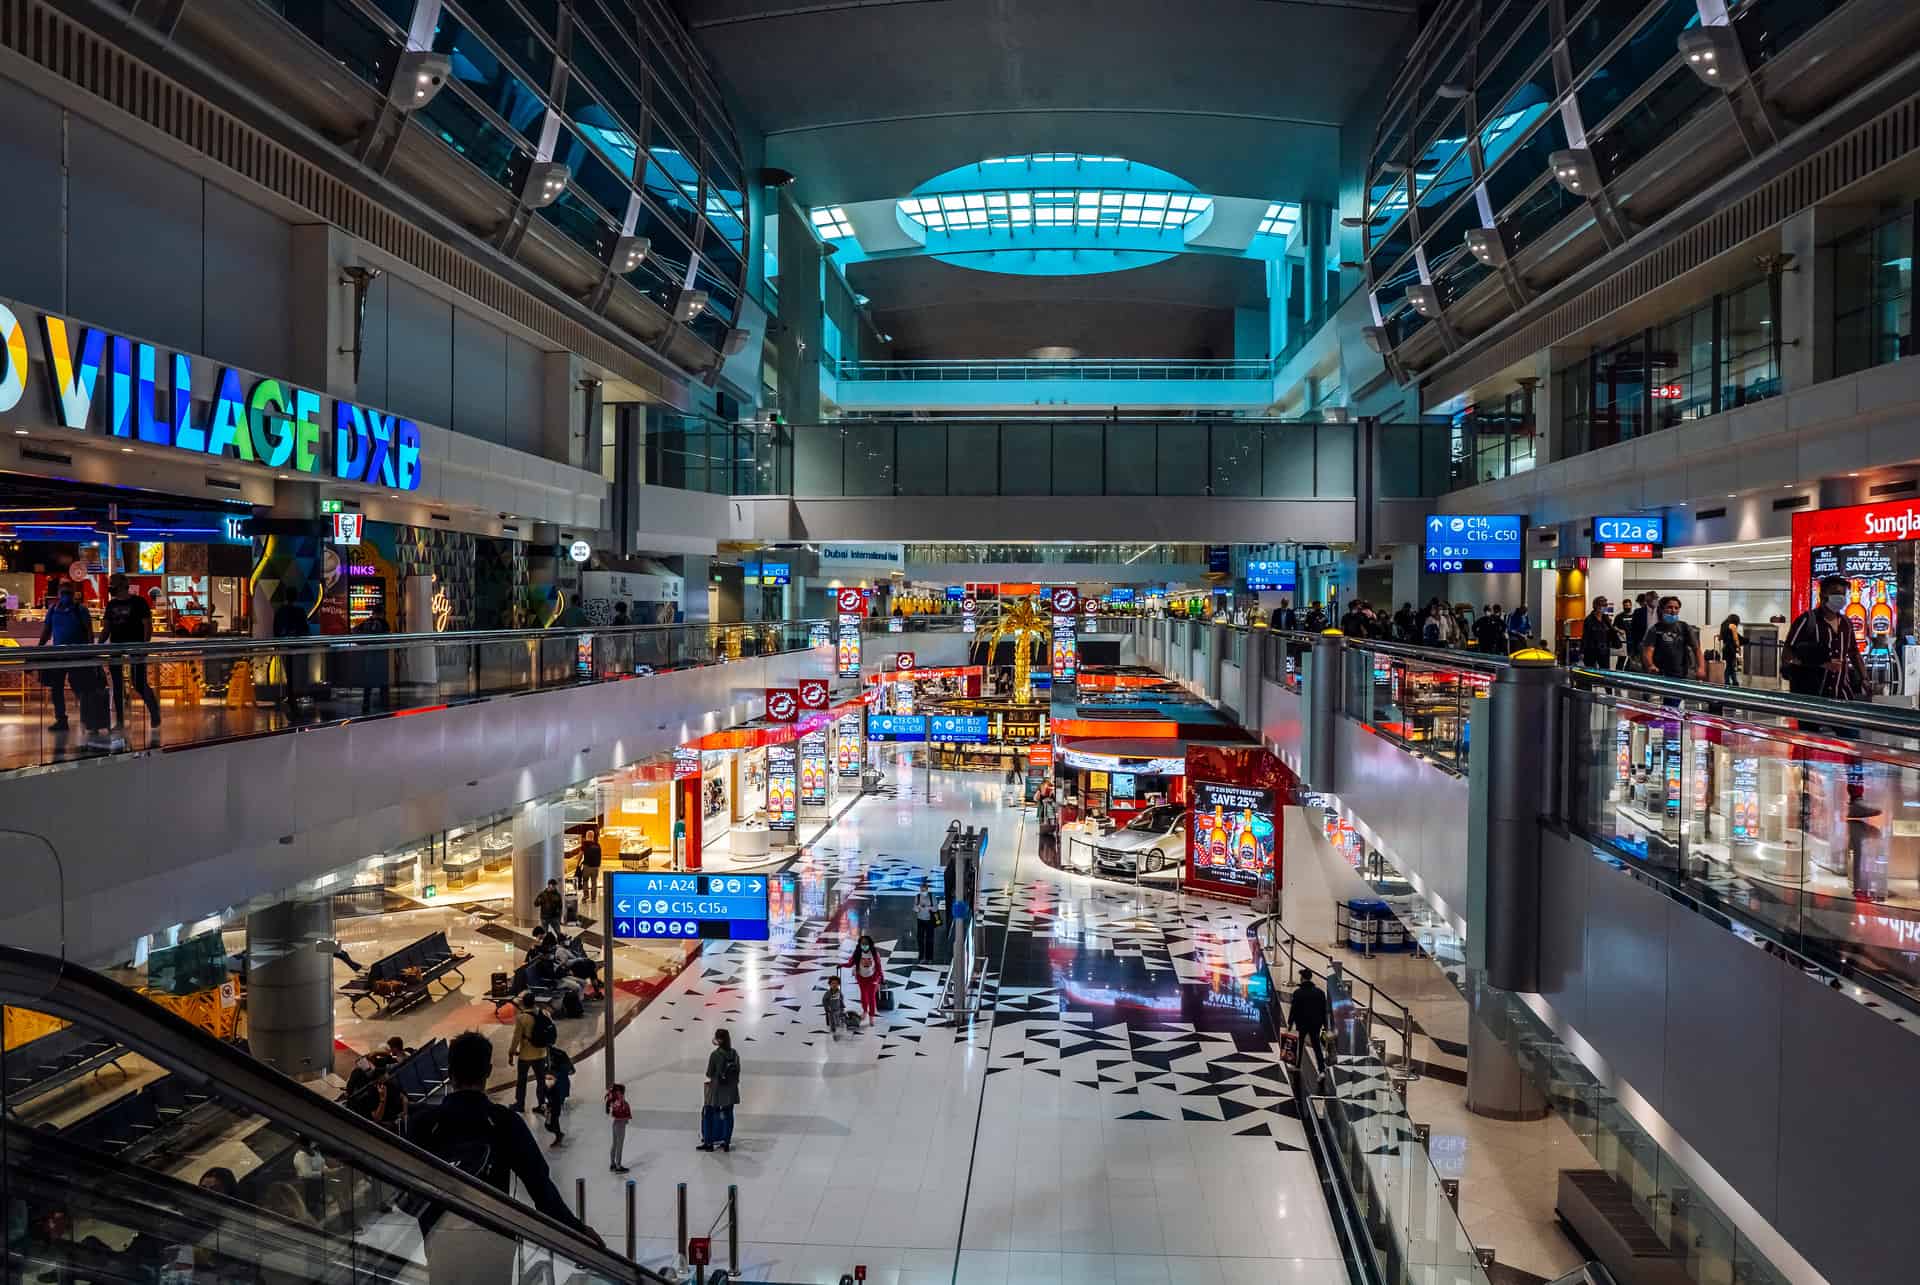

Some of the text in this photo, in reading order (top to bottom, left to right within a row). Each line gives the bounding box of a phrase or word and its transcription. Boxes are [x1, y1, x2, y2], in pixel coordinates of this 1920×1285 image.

[40, 315, 320, 475] VILLAGE
[334, 399, 422, 492] DXB
[1467, 517, 1490, 529] C14,
[1600, 522, 1642, 538] C12a
[1865, 508, 1920, 540] Sungla
[823, 548, 849, 560] Dubai
[1846, 562, 1892, 572] SAVE 25%
[1211, 793, 1258, 809] SAVE 25%
[647, 879, 698, 893] A1-A24,
[698, 902, 728, 914] C15a
